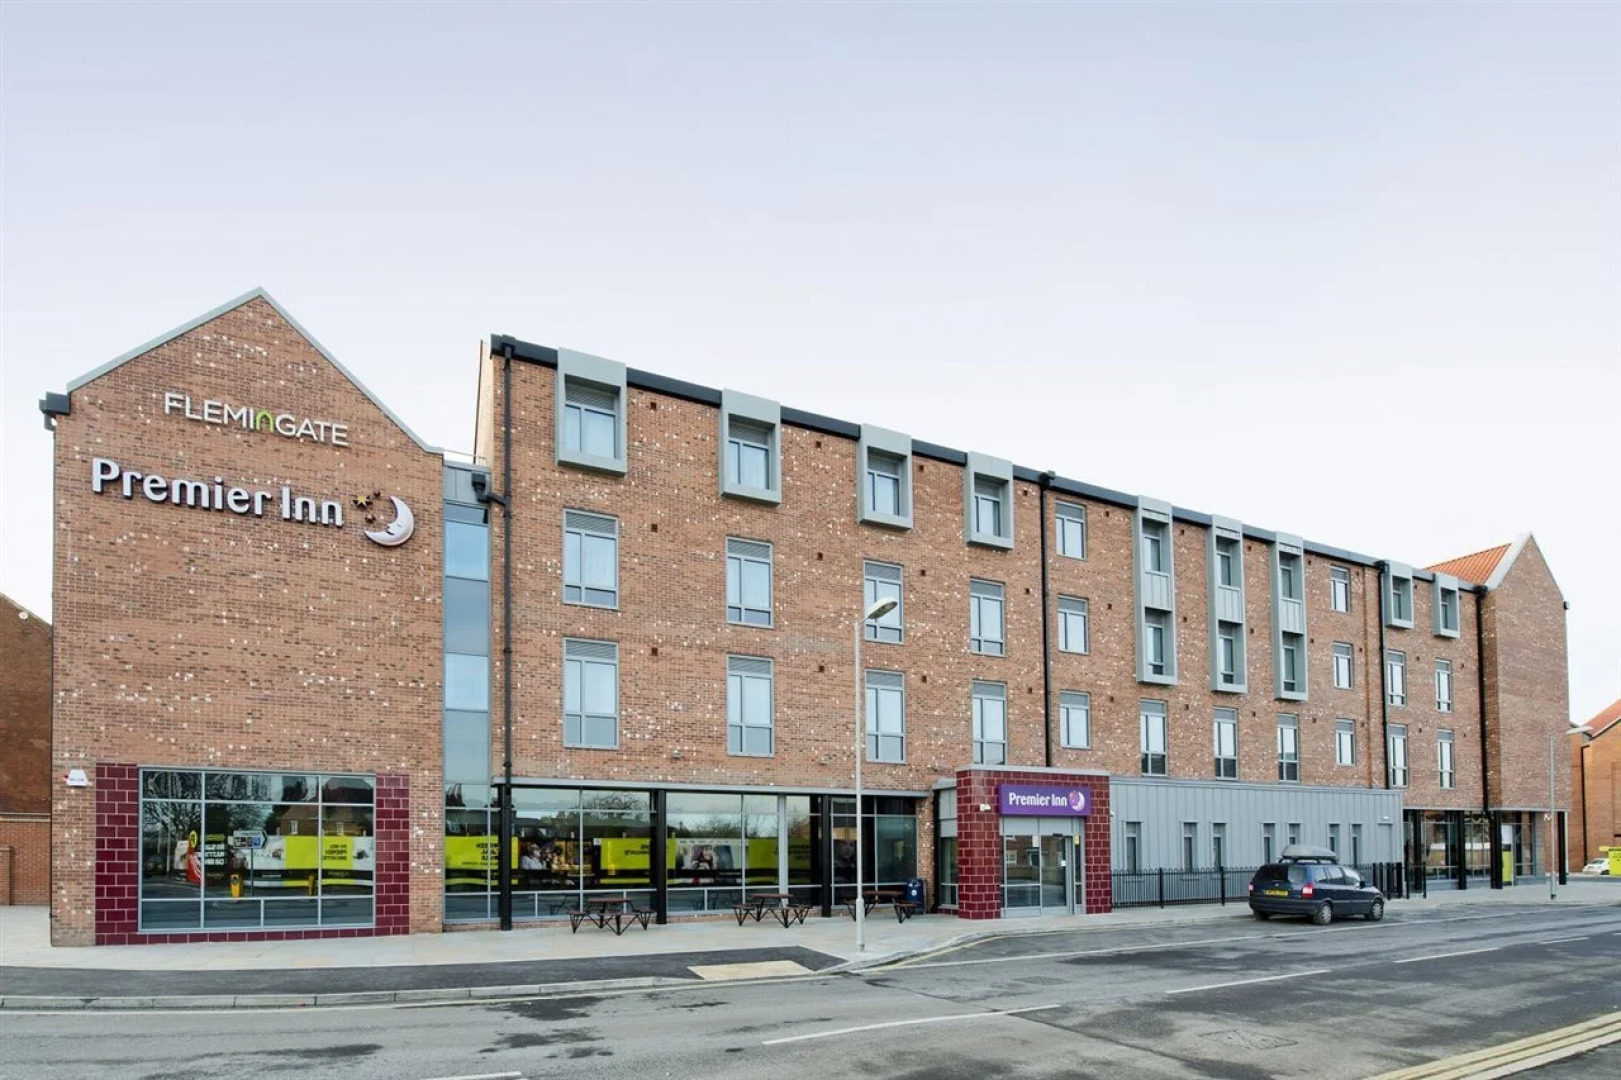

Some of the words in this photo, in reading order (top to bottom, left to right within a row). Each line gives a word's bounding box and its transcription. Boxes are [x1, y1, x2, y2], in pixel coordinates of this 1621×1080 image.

[91, 457, 272, 516] Premier
[281, 486, 343, 528] Inn
[1008, 792, 1051, 807] Premier
[1052, 793, 1068, 807] Inn
